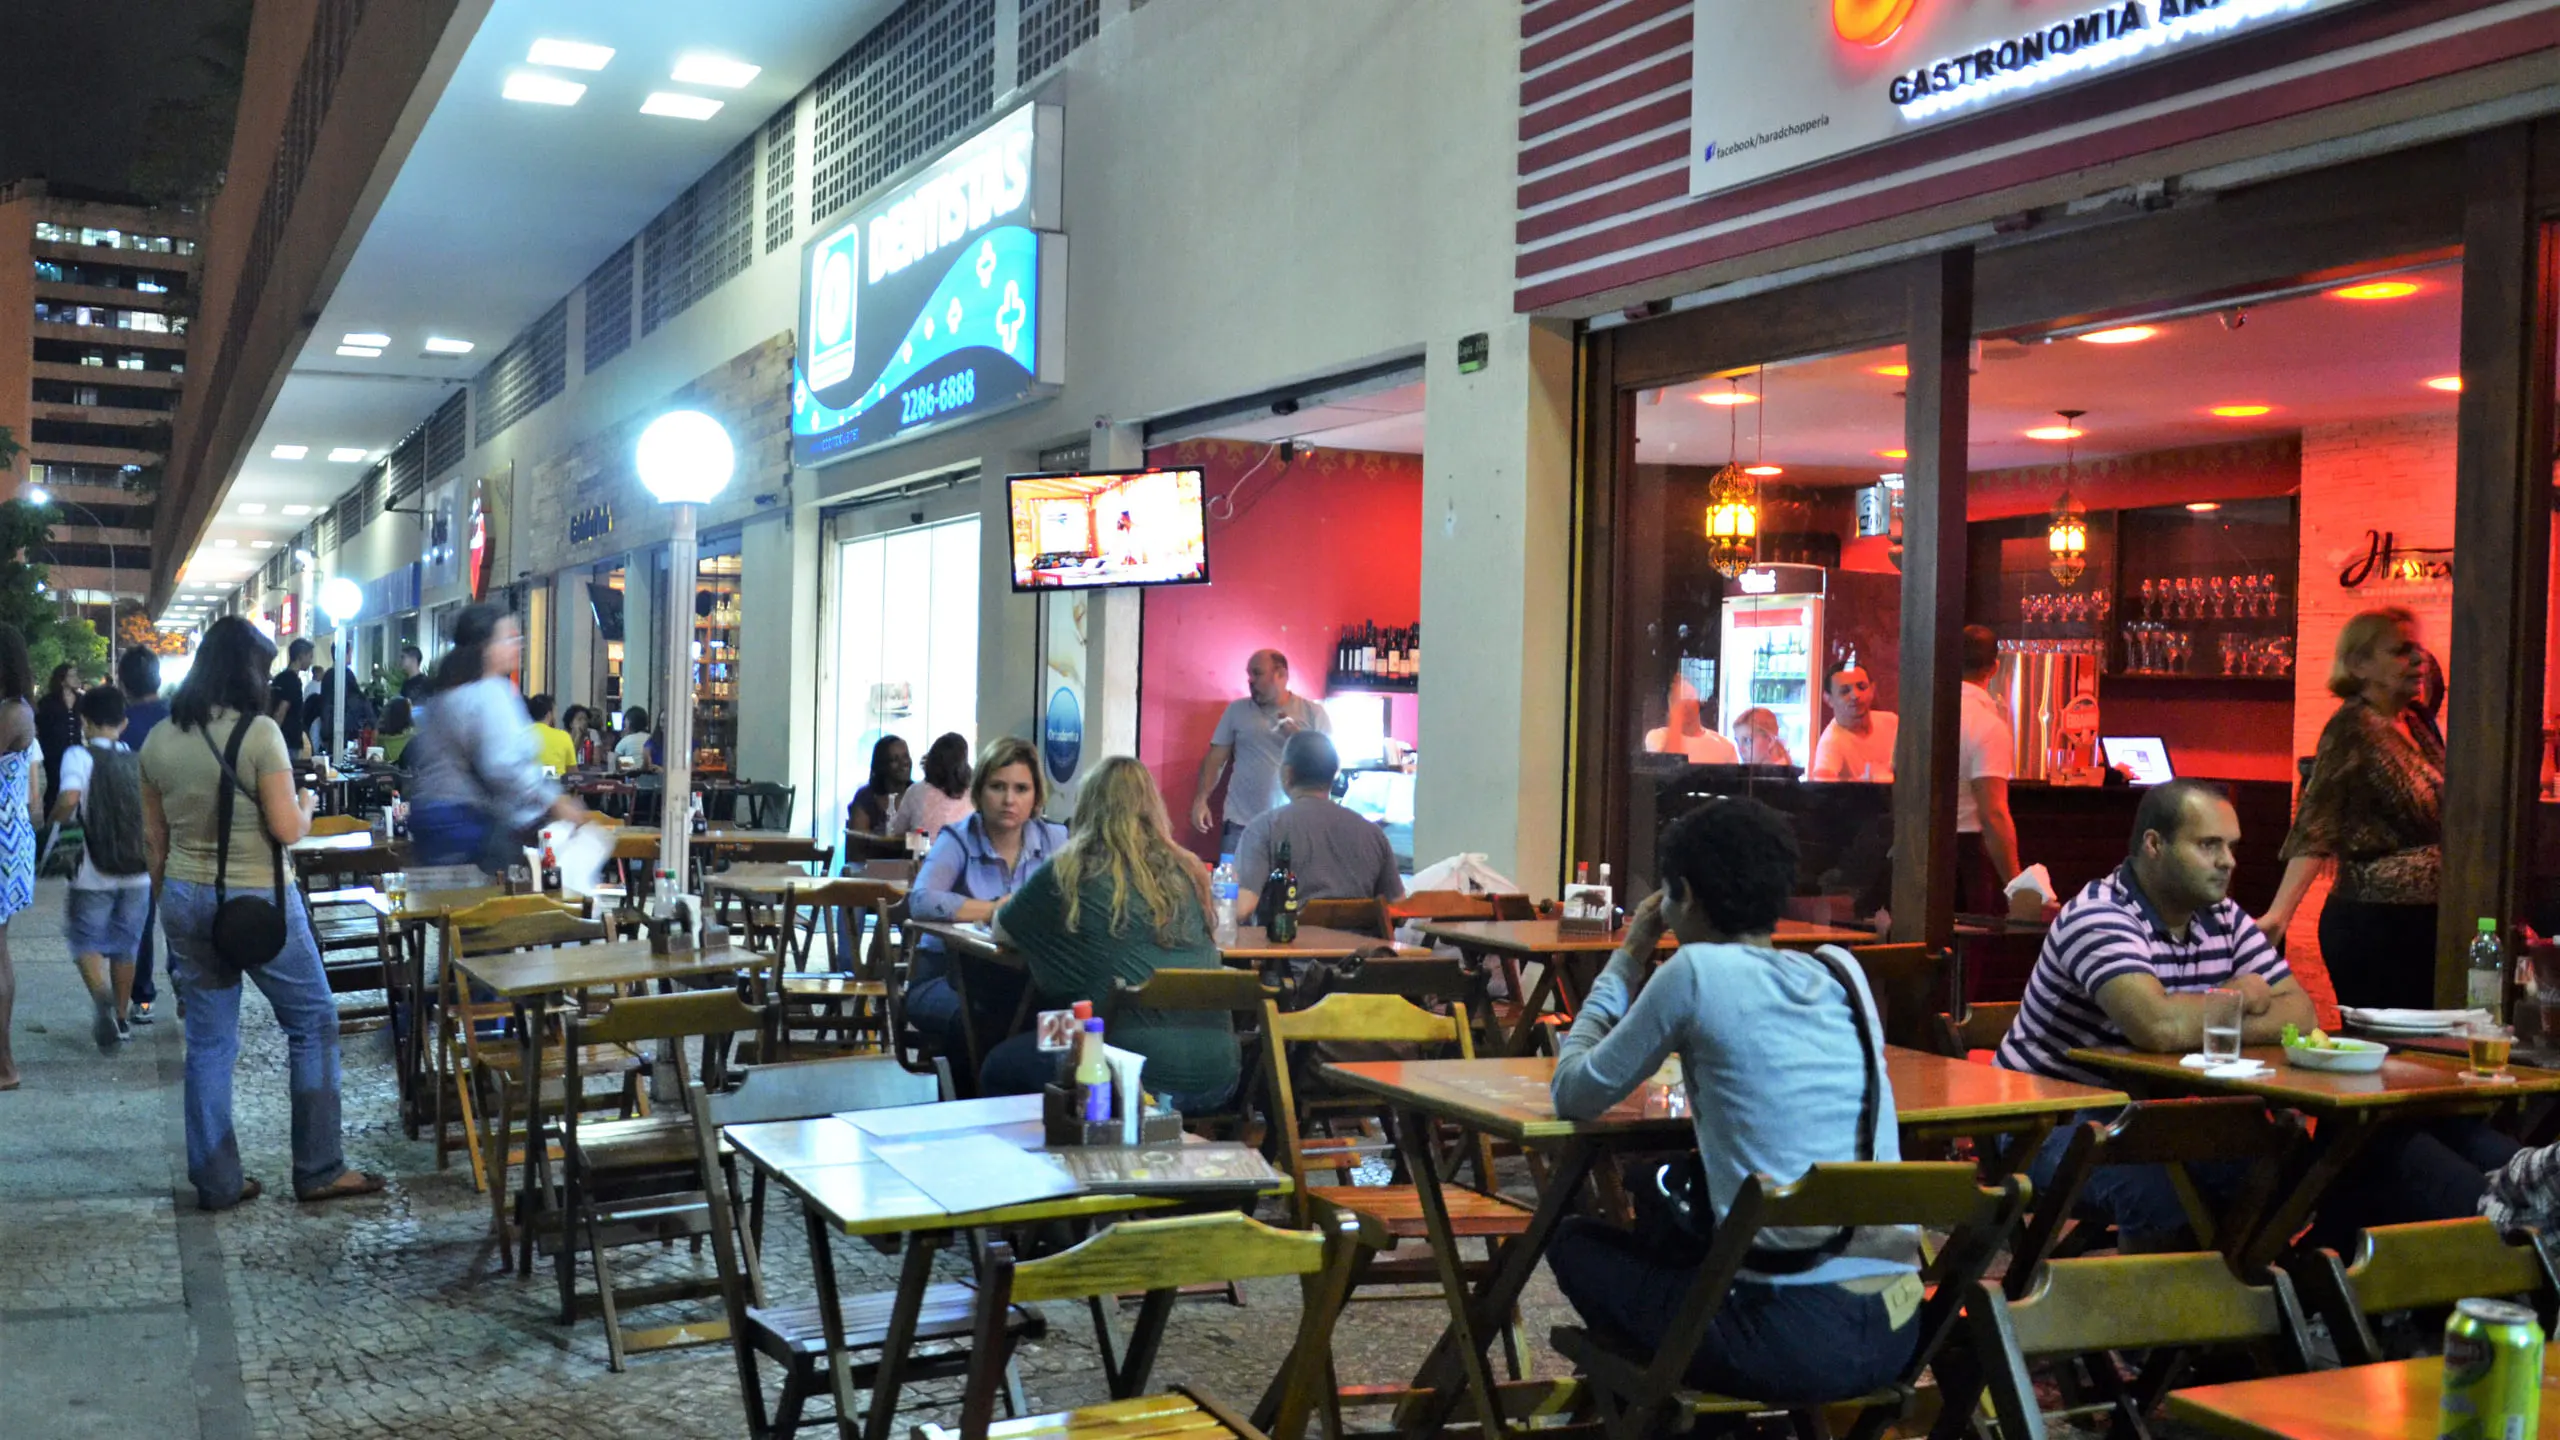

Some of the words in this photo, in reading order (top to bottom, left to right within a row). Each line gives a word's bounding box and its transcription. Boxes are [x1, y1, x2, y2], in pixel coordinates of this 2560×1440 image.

[1889, 1, 2141, 105] GASTRONOMIA
[1717, 113, 1830, 160] facebook/haradchopperia
[868, 130, 1030, 286] DENTISTAS
[900, 368, 976, 425] 2286-6888
